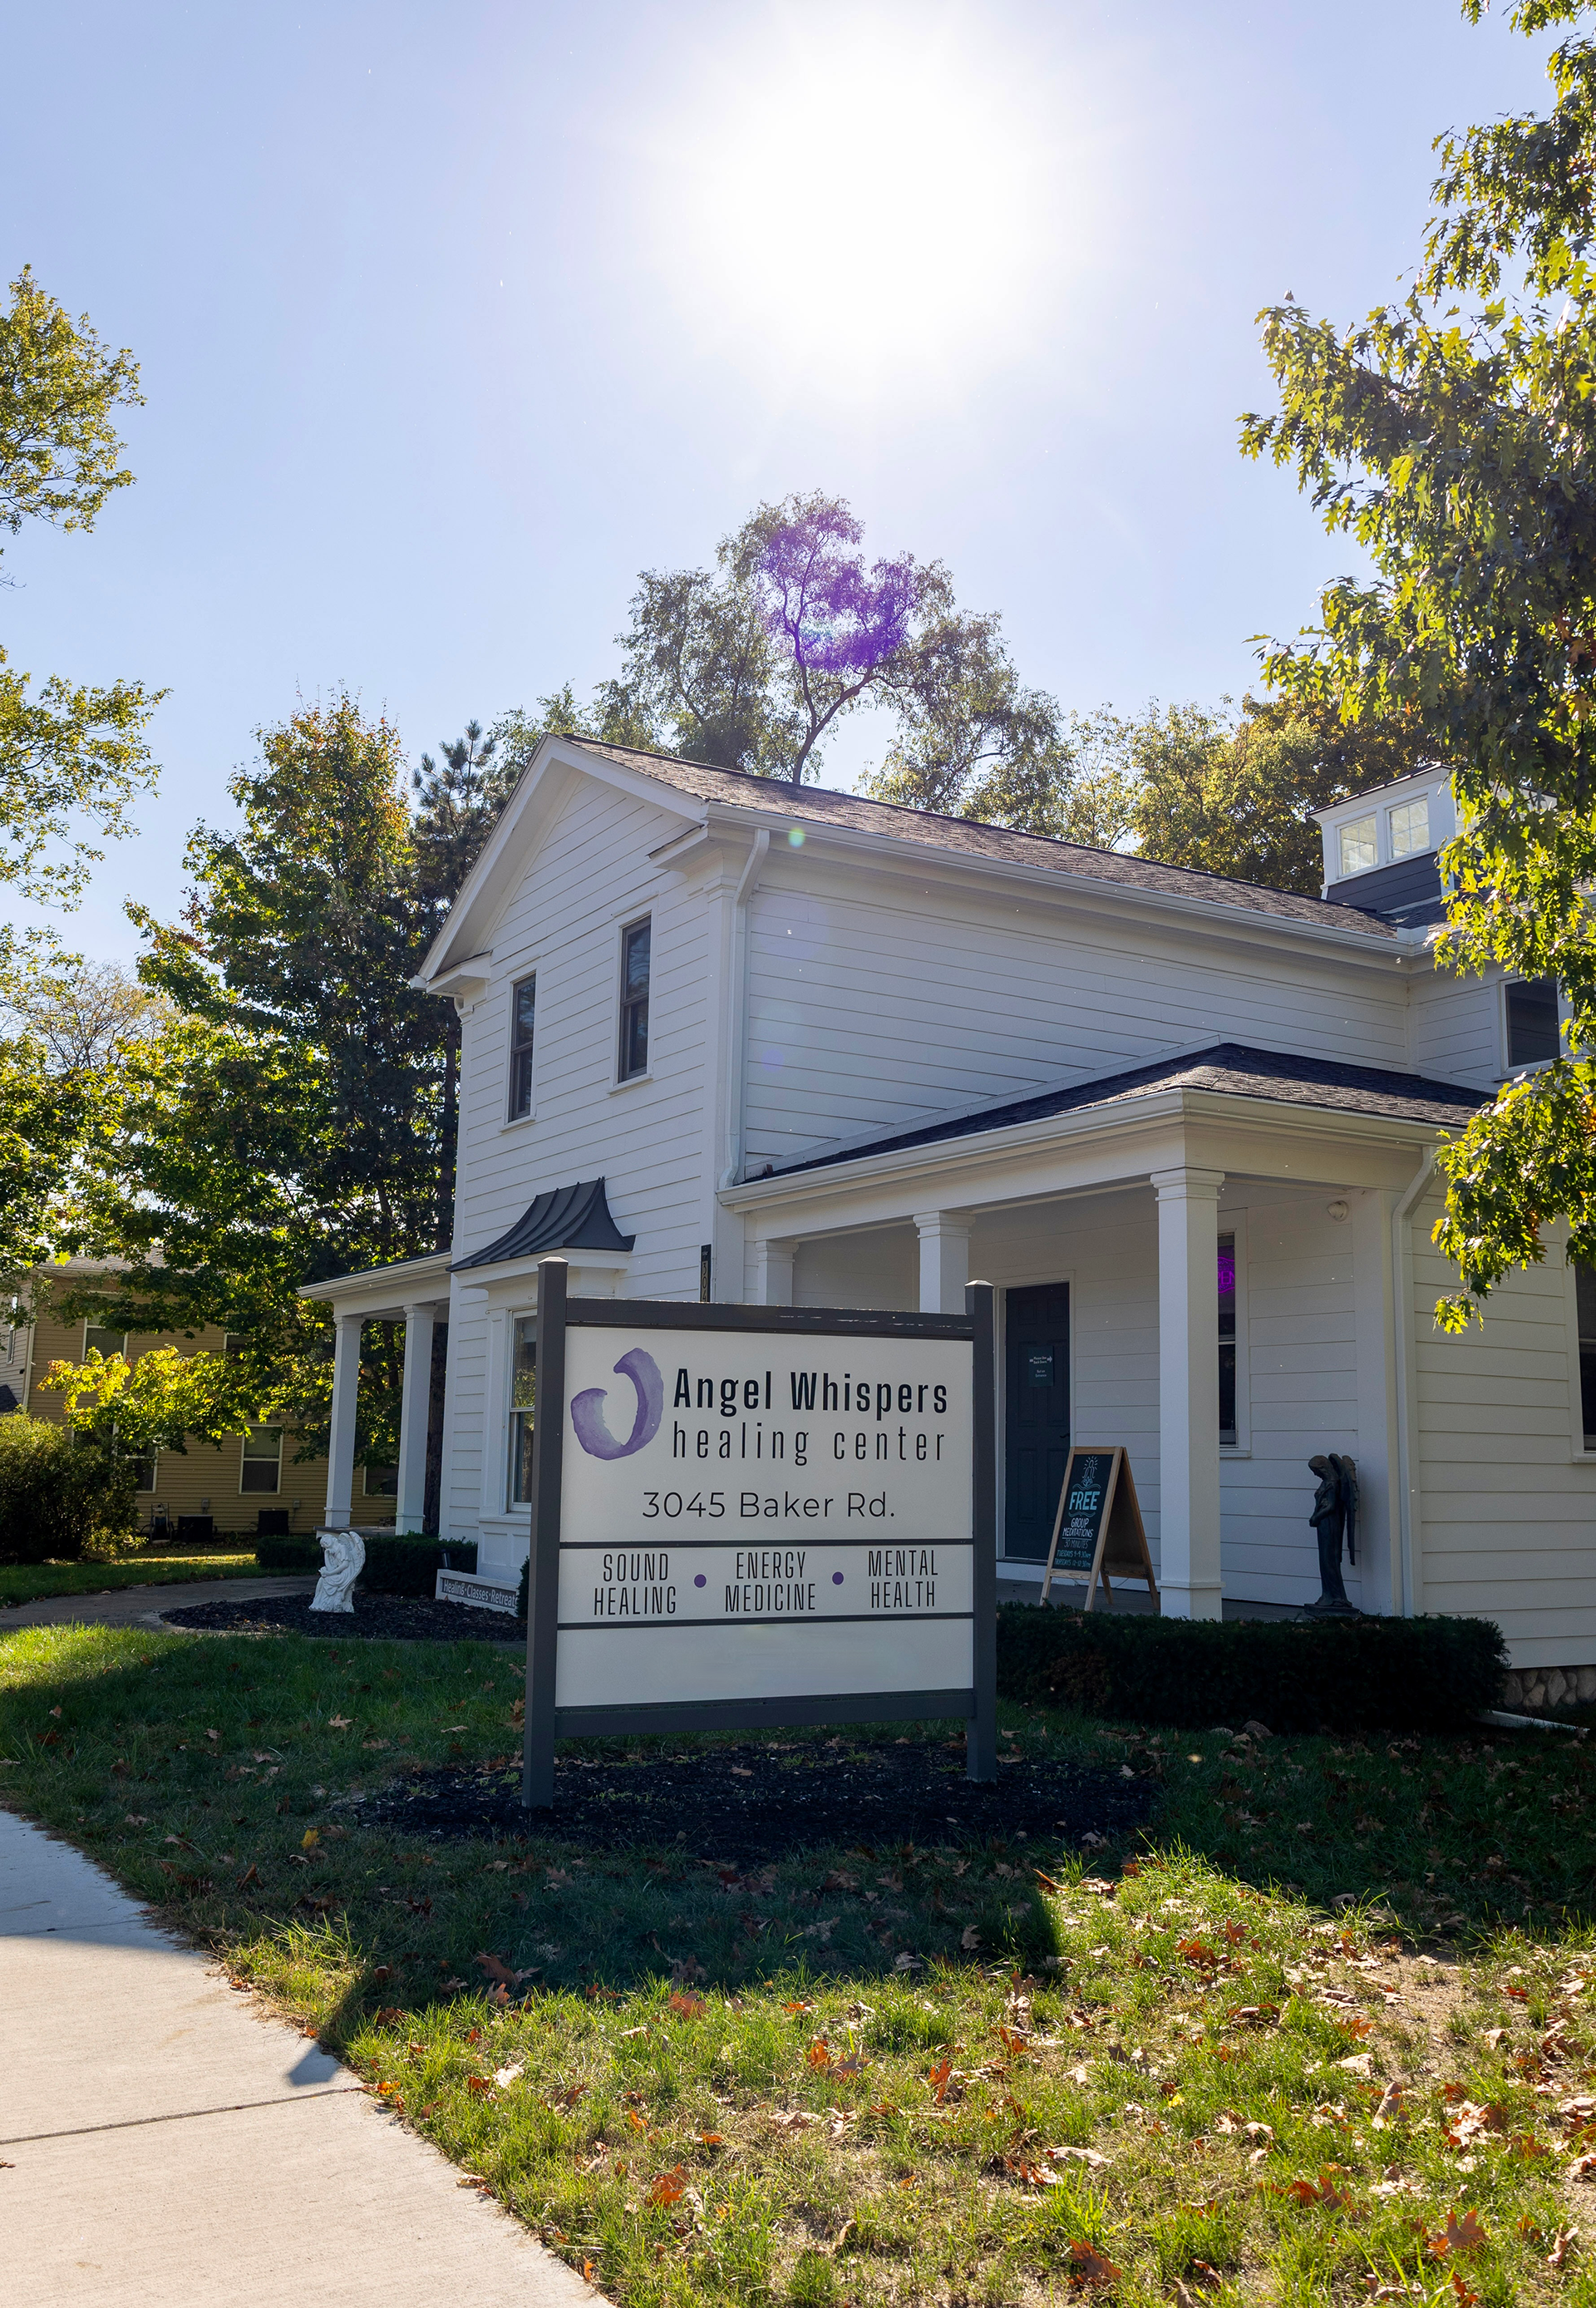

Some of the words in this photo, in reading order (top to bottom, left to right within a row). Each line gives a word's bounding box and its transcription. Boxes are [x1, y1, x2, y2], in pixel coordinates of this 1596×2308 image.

[673, 1368, 771, 1418] Angel
[791, 1372, 948, 1421] Whispers
[672, 1421, 810, 1467] healing
[834, 1426, 946, 1461] center
[643, 1492, 726, 1518] 3045
[739, 1491, 834, 1518] Baker
[847, 1492, 895, 1517] Rd.
[1069, 1491, 1101, 1511] FREE
[1062, 1527, 1094, 1537] MEDITATIONS
[1071, 1517, 1090, 1529] GROUP
[603, 1553, 669, 1582] SOUND
[736, 1551, 806, 1579] ENERGY
[868, 1550, 938, 1577] MENTAL
[443, 1580, 466, 1596] Healing
[466, 1586, 489, 1601] Classes
[594, 1586, 677, 1615] HEALING
[725, 1584, 816, 1612] MEDICINE
[870, 1581, 936, 1609] HEALTH
